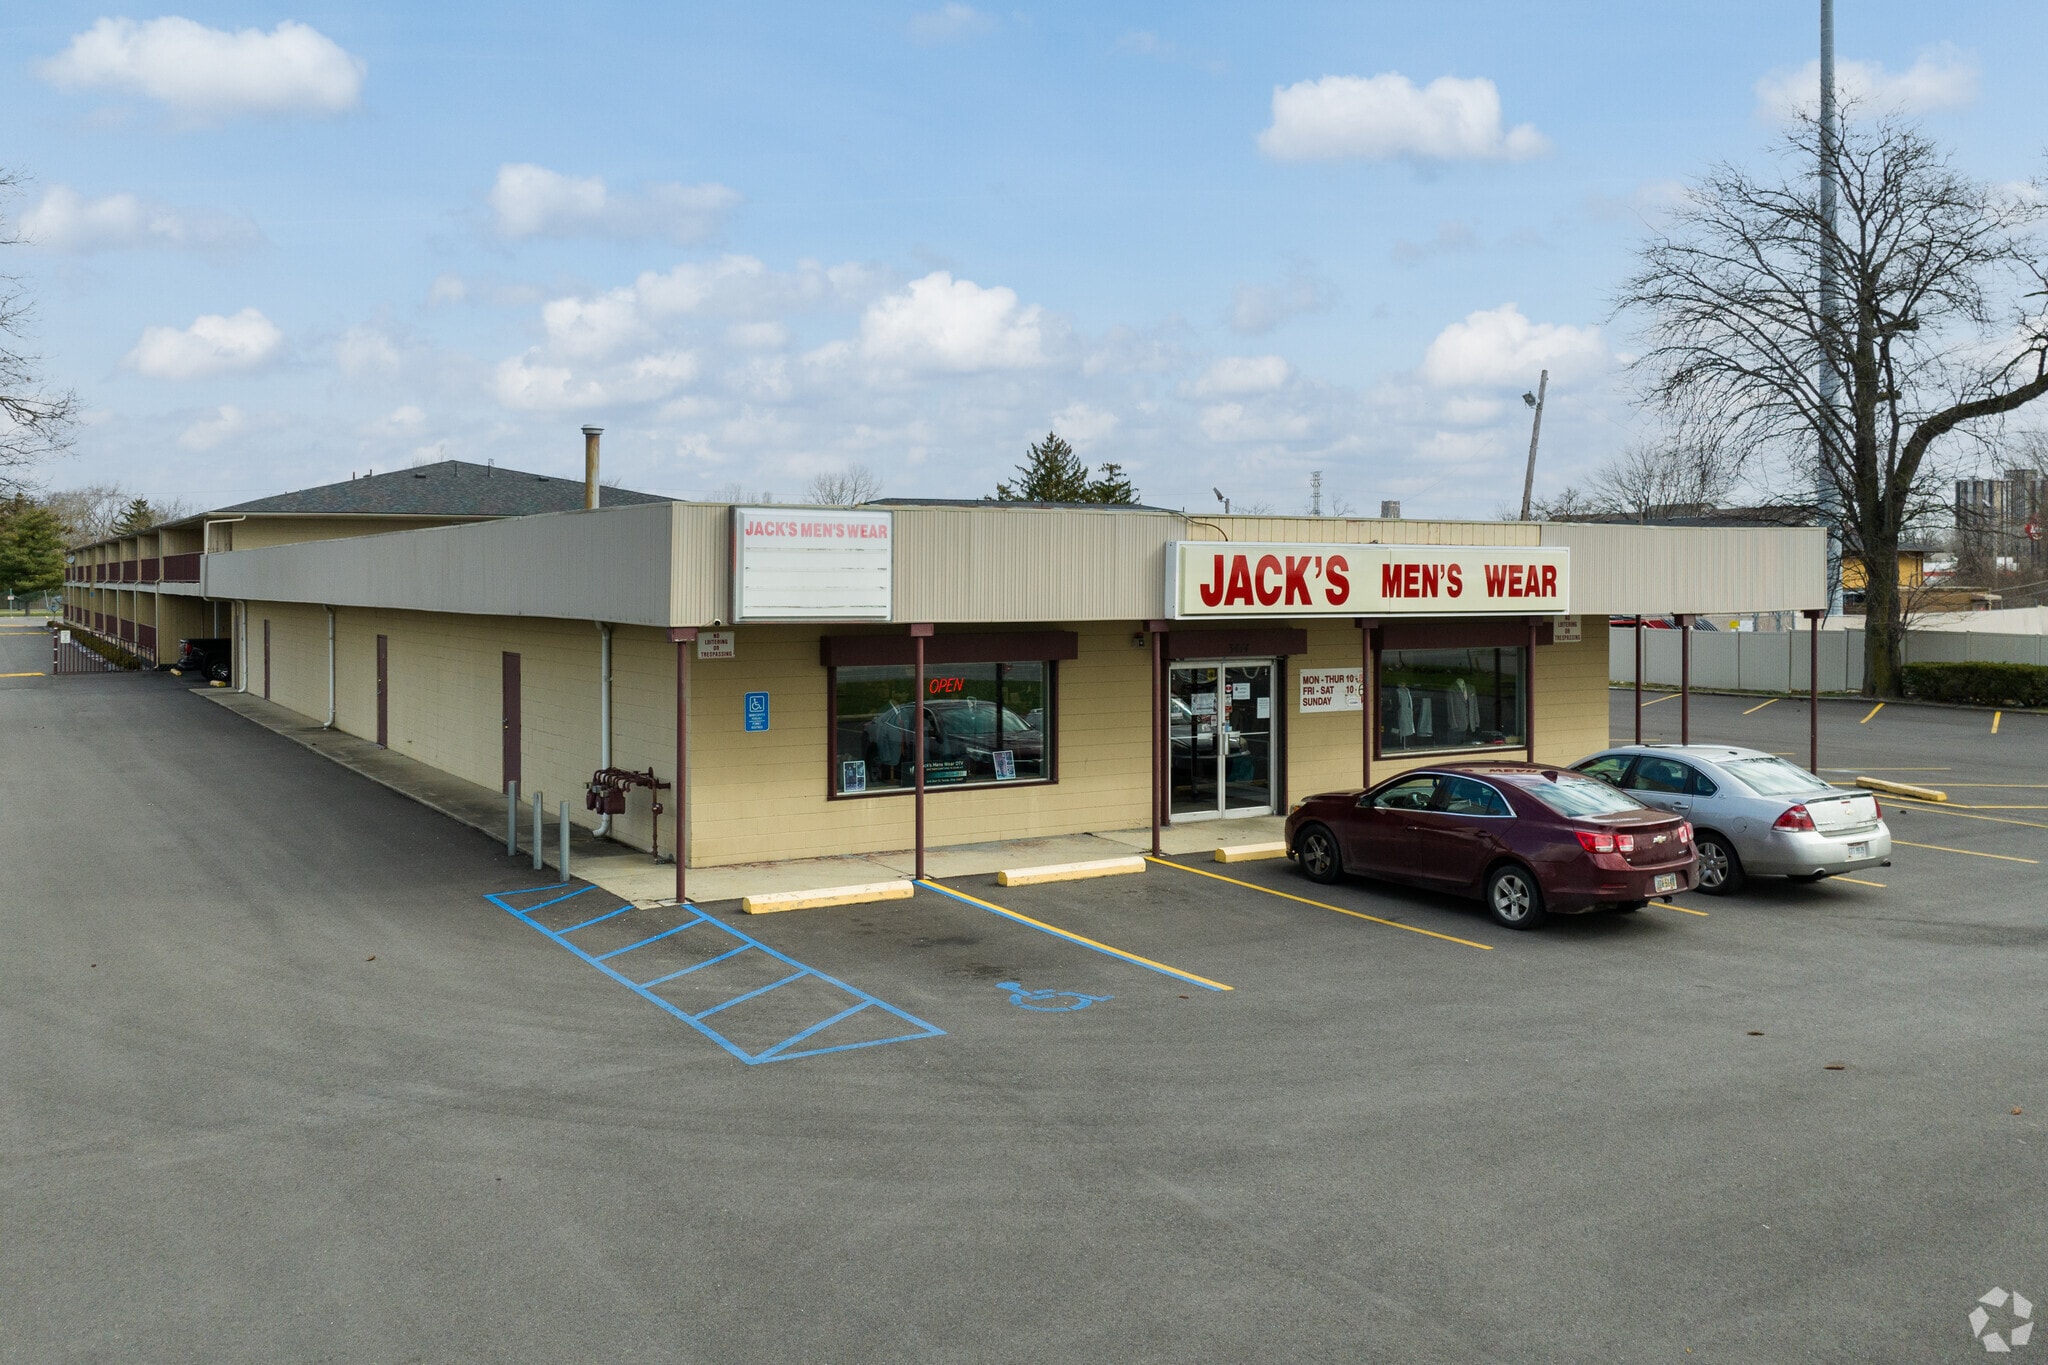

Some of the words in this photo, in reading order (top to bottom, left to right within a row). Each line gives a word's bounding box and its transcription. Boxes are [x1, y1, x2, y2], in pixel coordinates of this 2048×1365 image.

[745, 521, 798, 537] JACK'S
[800, 523, 845, 538] MEN'S
[847, 524, 888, 539] WEAR
[1200, 554, 1350, 606] JACK'S
[1381, 563, 1463, 598] MEN'S
[1484, 564, 1557, 598] WEAR
[929, 677, 964, 694] OPEN
[1303, 676, 1319, 684] MON
[1325, 675, 1344, 683] THUR
[1346, 674, 1354, 683] 10
[1303, 687, 1314, 695] FRI
[1320, 686, 1334, 694] SAT
[1346, 686, 1354, 694] 10
[1303, 697, 1332, 706] SUNDAY
